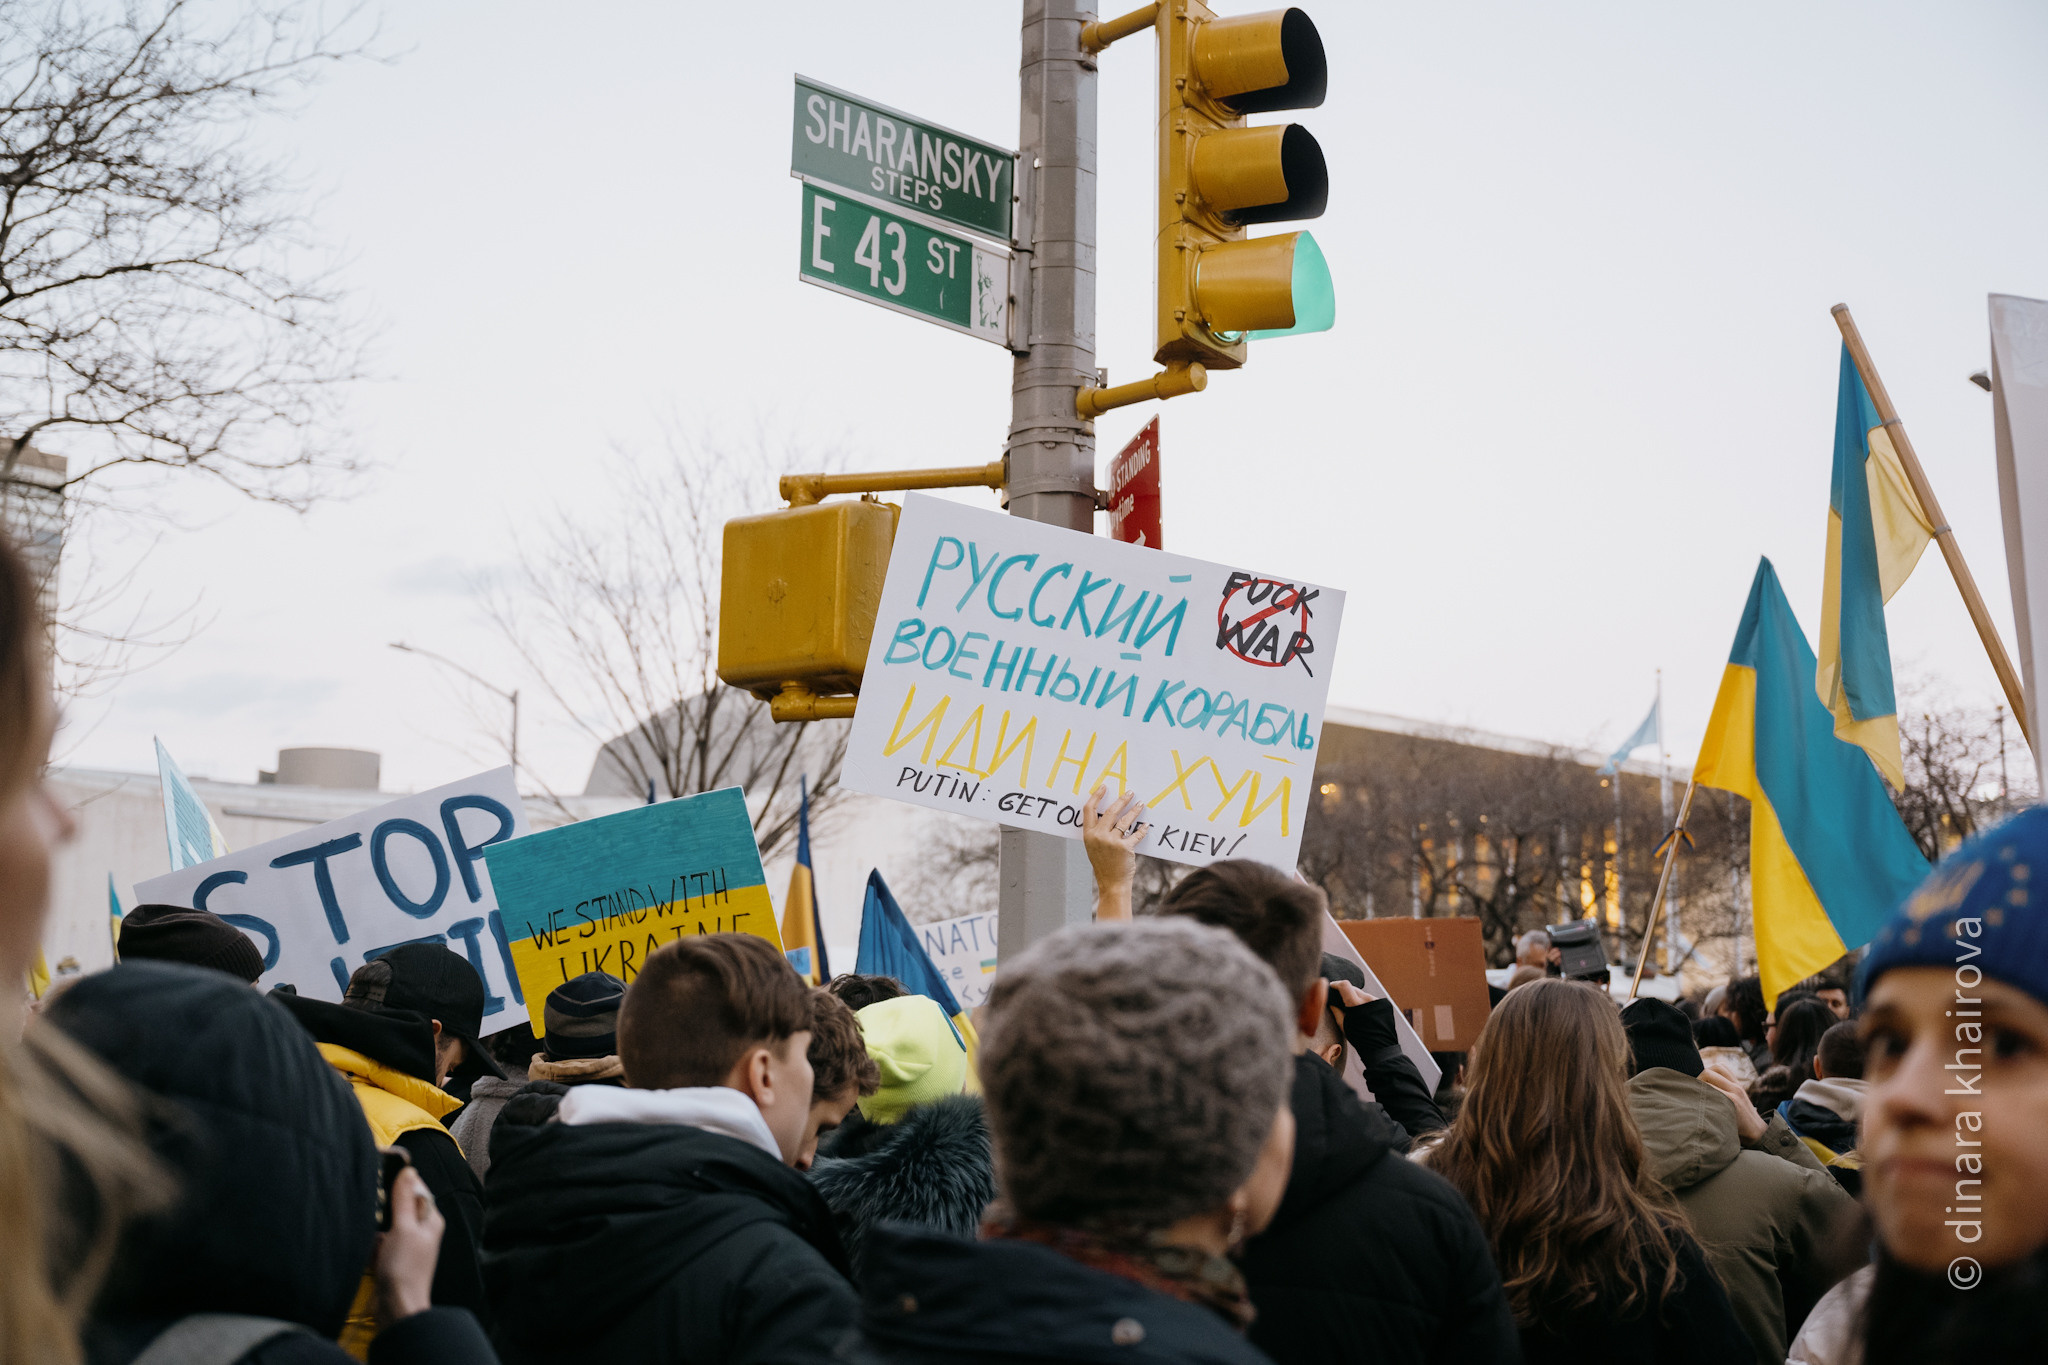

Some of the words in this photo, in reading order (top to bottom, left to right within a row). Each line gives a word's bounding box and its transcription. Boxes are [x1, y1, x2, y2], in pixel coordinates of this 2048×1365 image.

[805, 94, 1003, 203] SHARANSKY
[870, 166, 943, 211] STEPS
[812, 194, 837, 274] E
[854, 214, 907, 297] 43
[926, 236, 961, 280] ST
[1116, 439, 1151, 493] STANDING
[916, 535, 1193, 658] РУССКИЙ
[1222, 571, 1320, 619] FUCK
[883, 617, 1142, 718] ВОЕННЫЙ
[1142, 678, 1316, 751] КОРАБЛЬ
[1215, 613, 1315, 679] WAR
[882, 682, 1039, 791] ИДИ
[1045, 727, 1129, 797] НА
[1146, 748, 1298, 837] ХУЙ
[998, 792, 1058, 819] GET
[1056, 804, 1104, 829] OU
[192, 794, 516, 972] STOP
[526, 908, 571, 951] WE
[575, 887, 648, 939] STAND
[647, 867, 729, 919] WITH
